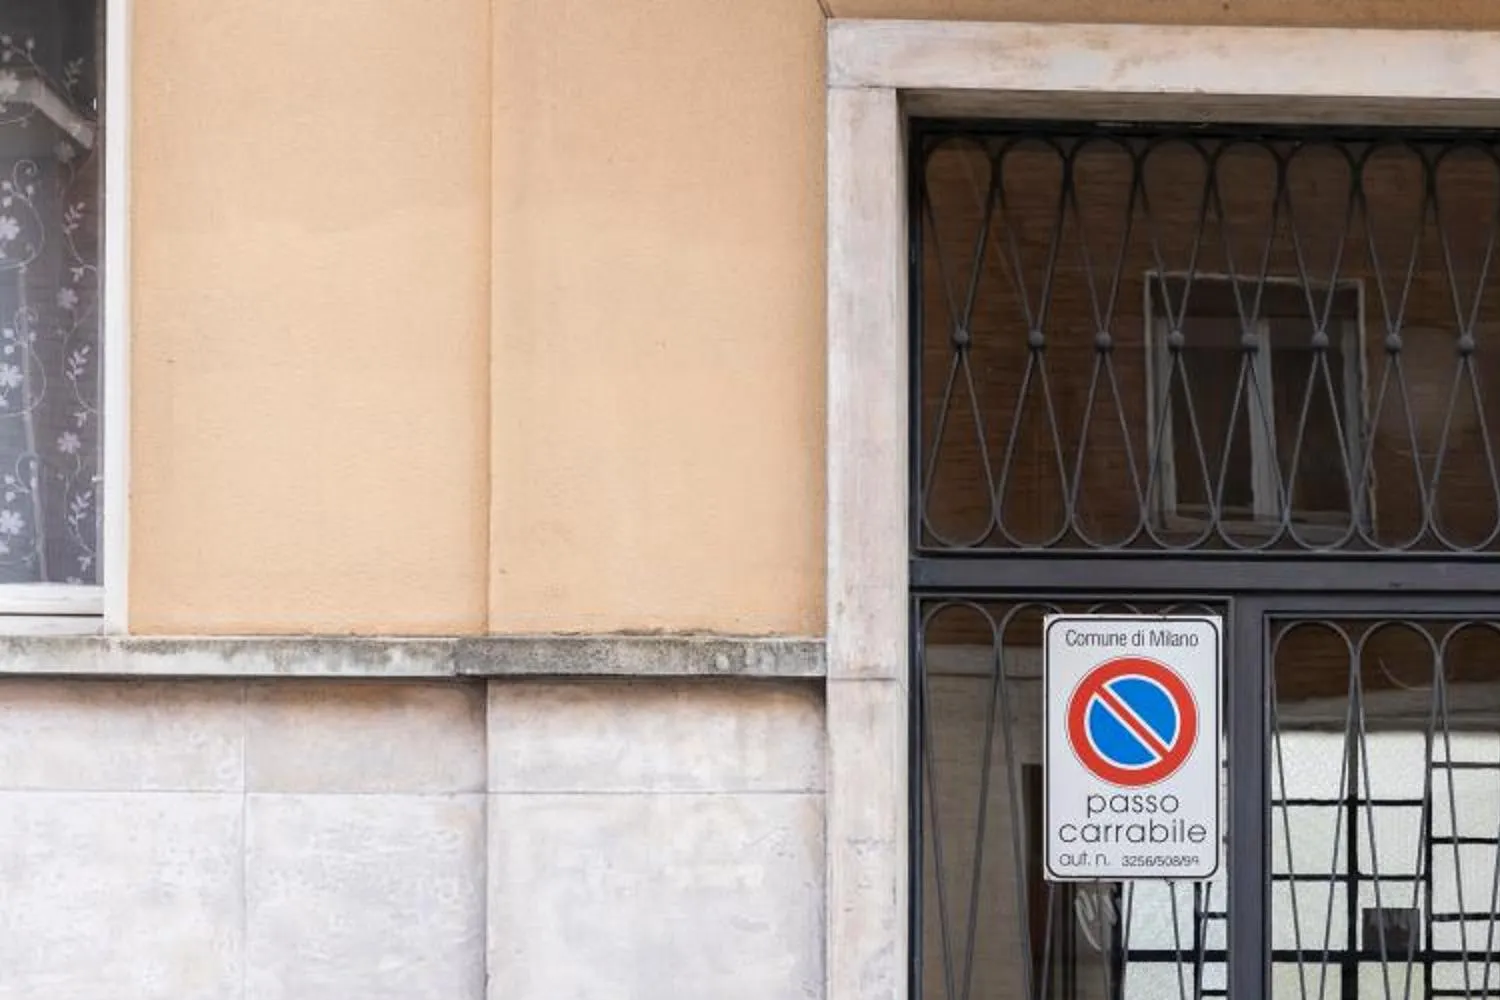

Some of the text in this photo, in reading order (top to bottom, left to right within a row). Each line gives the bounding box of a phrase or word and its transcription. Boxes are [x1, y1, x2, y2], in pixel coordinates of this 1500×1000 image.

[1065, 629, 1199, 647] Comune di Milano
[1087, 793, 1179, 818] passo
[1058, 819, 1207, 843] carrabile
[1059, 850, 1091, 867] aut.
[1095, 853, 1111, 867] n.
